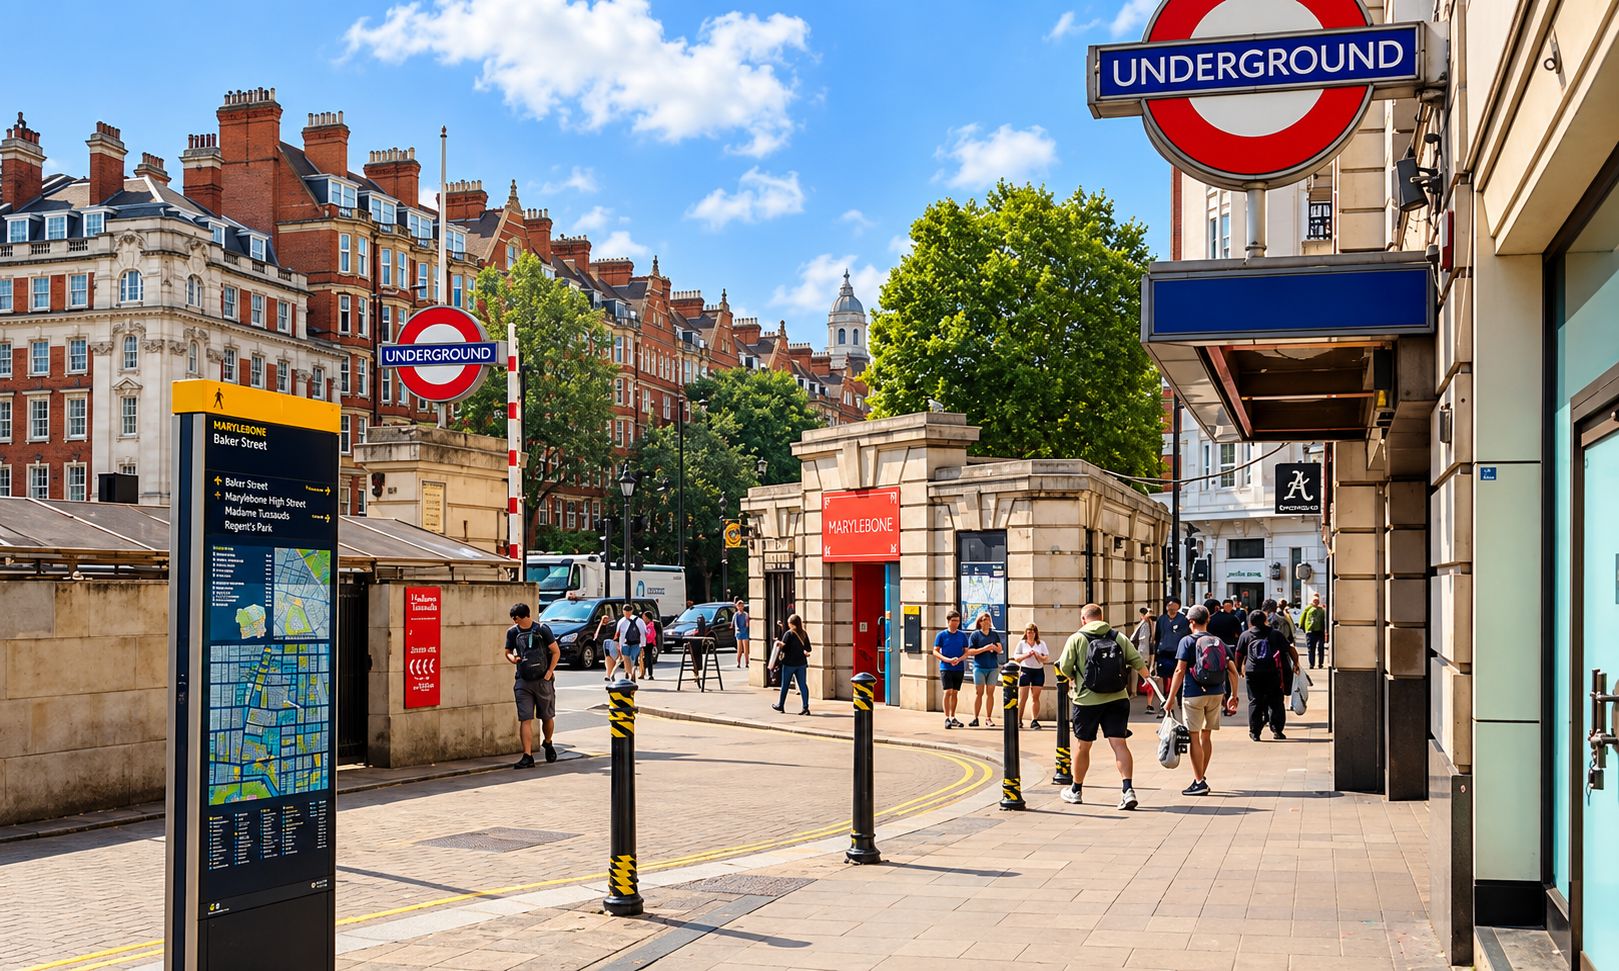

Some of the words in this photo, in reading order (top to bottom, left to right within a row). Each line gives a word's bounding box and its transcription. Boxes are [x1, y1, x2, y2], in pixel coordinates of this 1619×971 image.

[1113, 40, 1403, 87] UNDERGROUND
[385, 347, 491, 362] UNDERGROUND
[213, 420, 267, 436] MARYLEBONE
[213, 433, 240, 447] Baker
[240, 436, 268, 451] Street
[225, 477, 246, 488] Baker
[246, 479, 269, 491] Street
[225, 491, 267, 505] Marylebone
[268, 495, 285, 508] High
[285, 497, 307, 509] Street
[225, 506, 257, 518] Madame
[224, 520, 256, 533] Regent's
[256, 522, 273, 533] Park
[828, 517, 893, 534] MARYLEBONE
